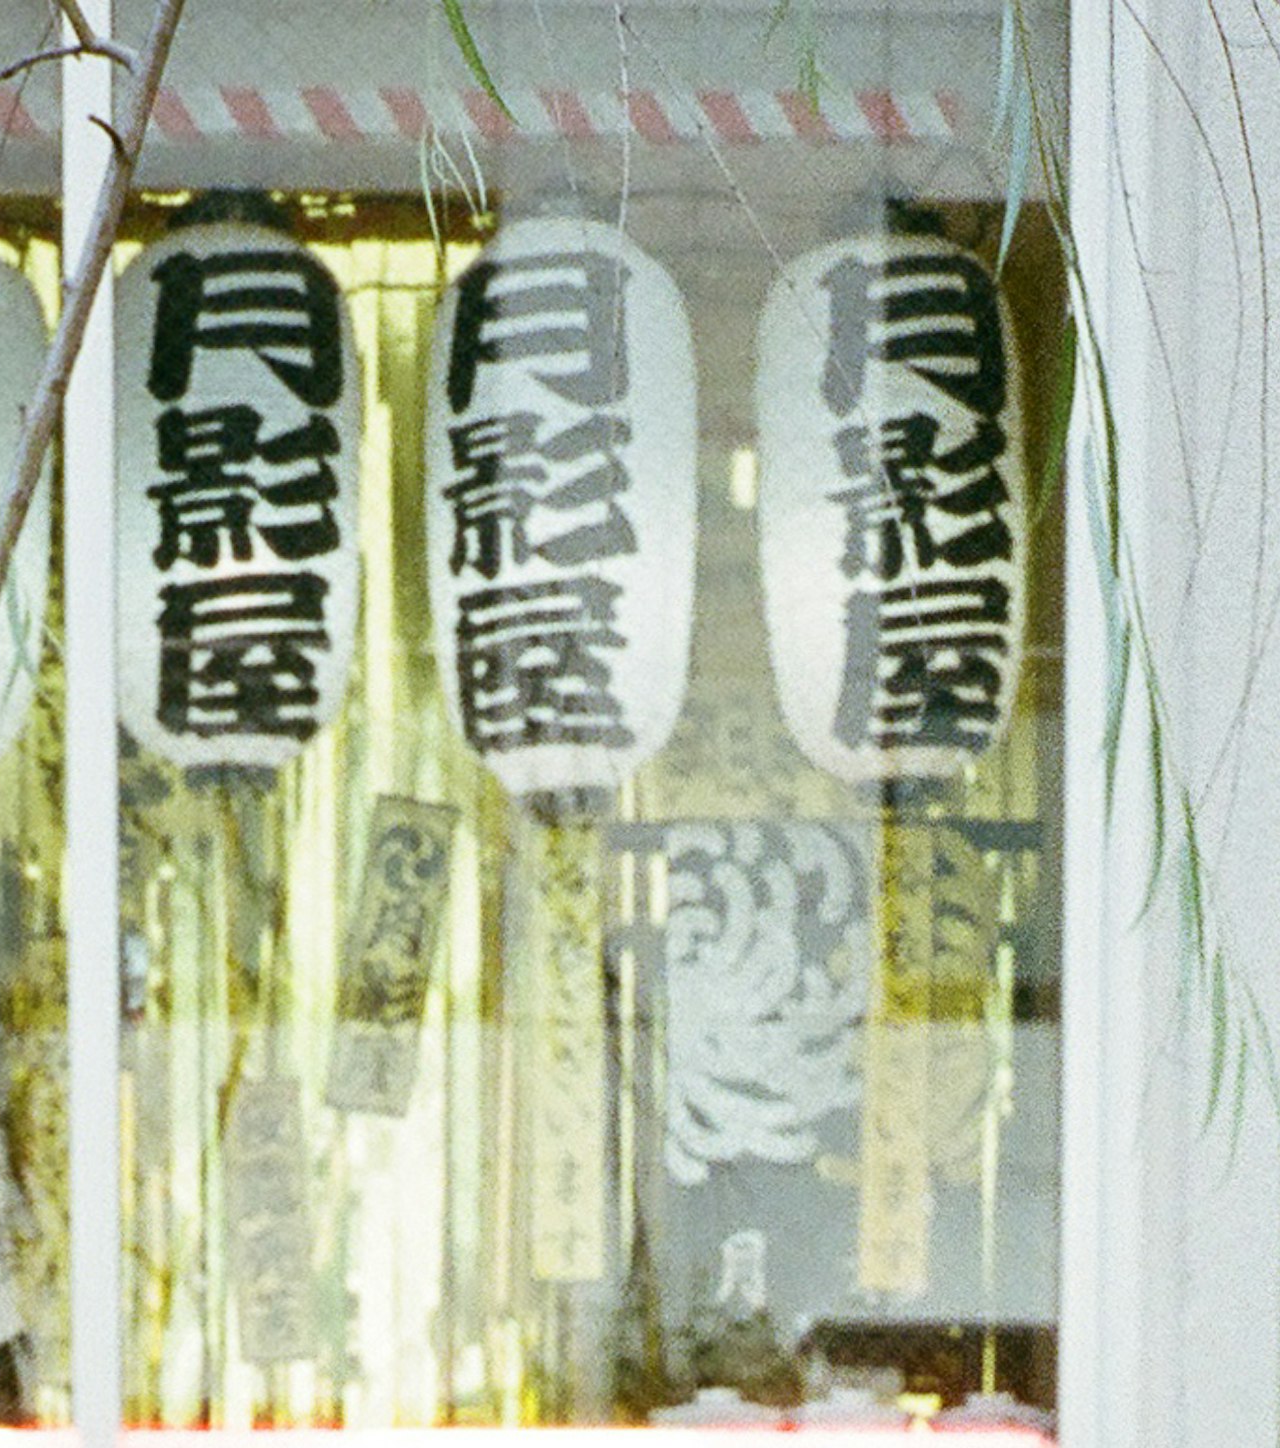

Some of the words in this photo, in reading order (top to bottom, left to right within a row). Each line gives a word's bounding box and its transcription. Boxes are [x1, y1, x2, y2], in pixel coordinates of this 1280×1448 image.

[147, 249, 342, 740] 月影屋
[443, 249, 637, 753] 月影屋
[819, 251, 1012, 751] 月影屋
